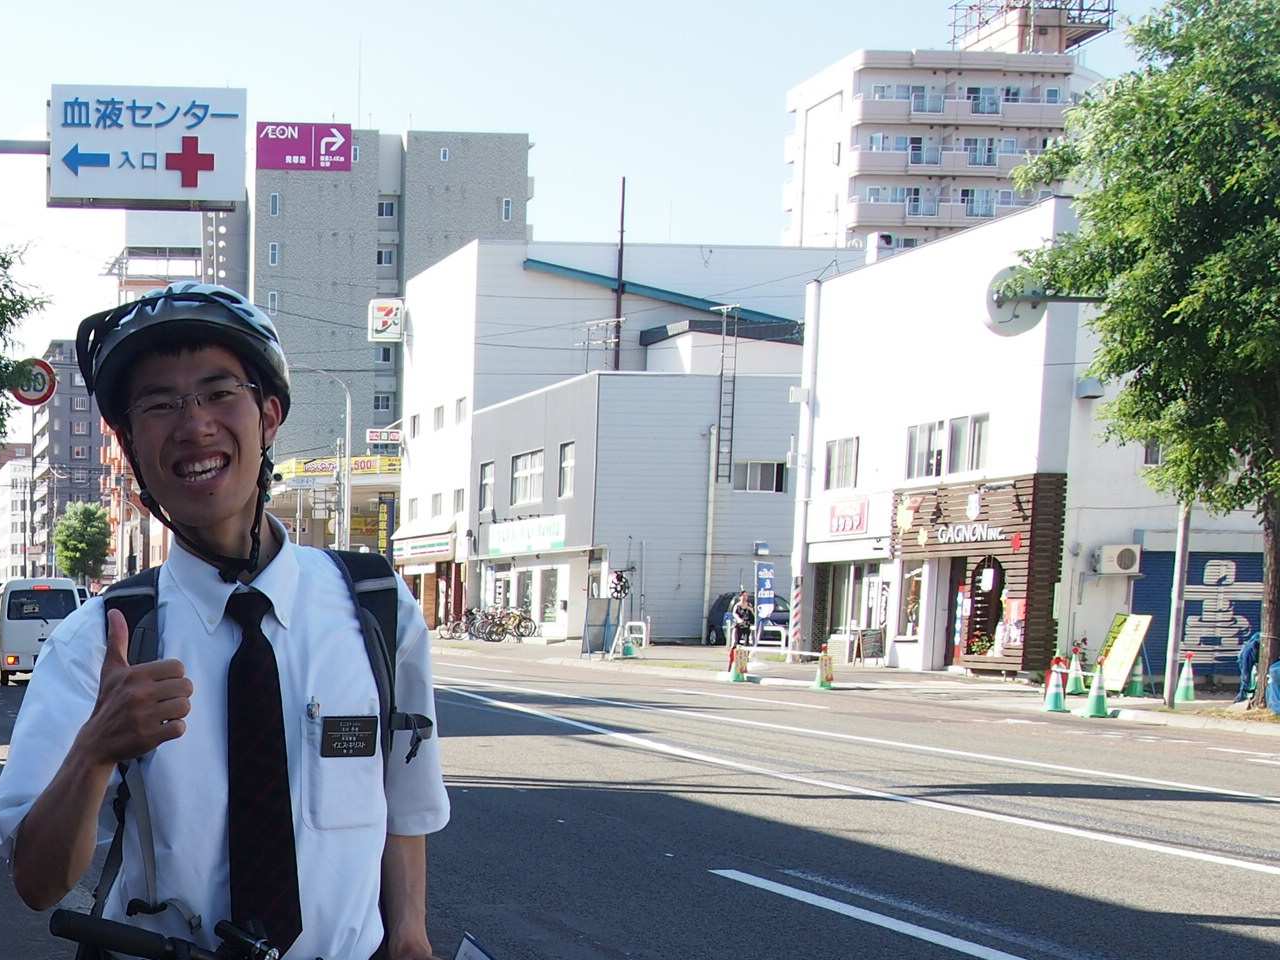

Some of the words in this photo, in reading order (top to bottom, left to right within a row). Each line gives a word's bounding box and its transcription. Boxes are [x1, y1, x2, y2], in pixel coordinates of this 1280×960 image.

[61, 96, 239, 130] 血液センター
[118, 151, 158, 170] 入口
[937, 523, 988, 543] GAGNON
